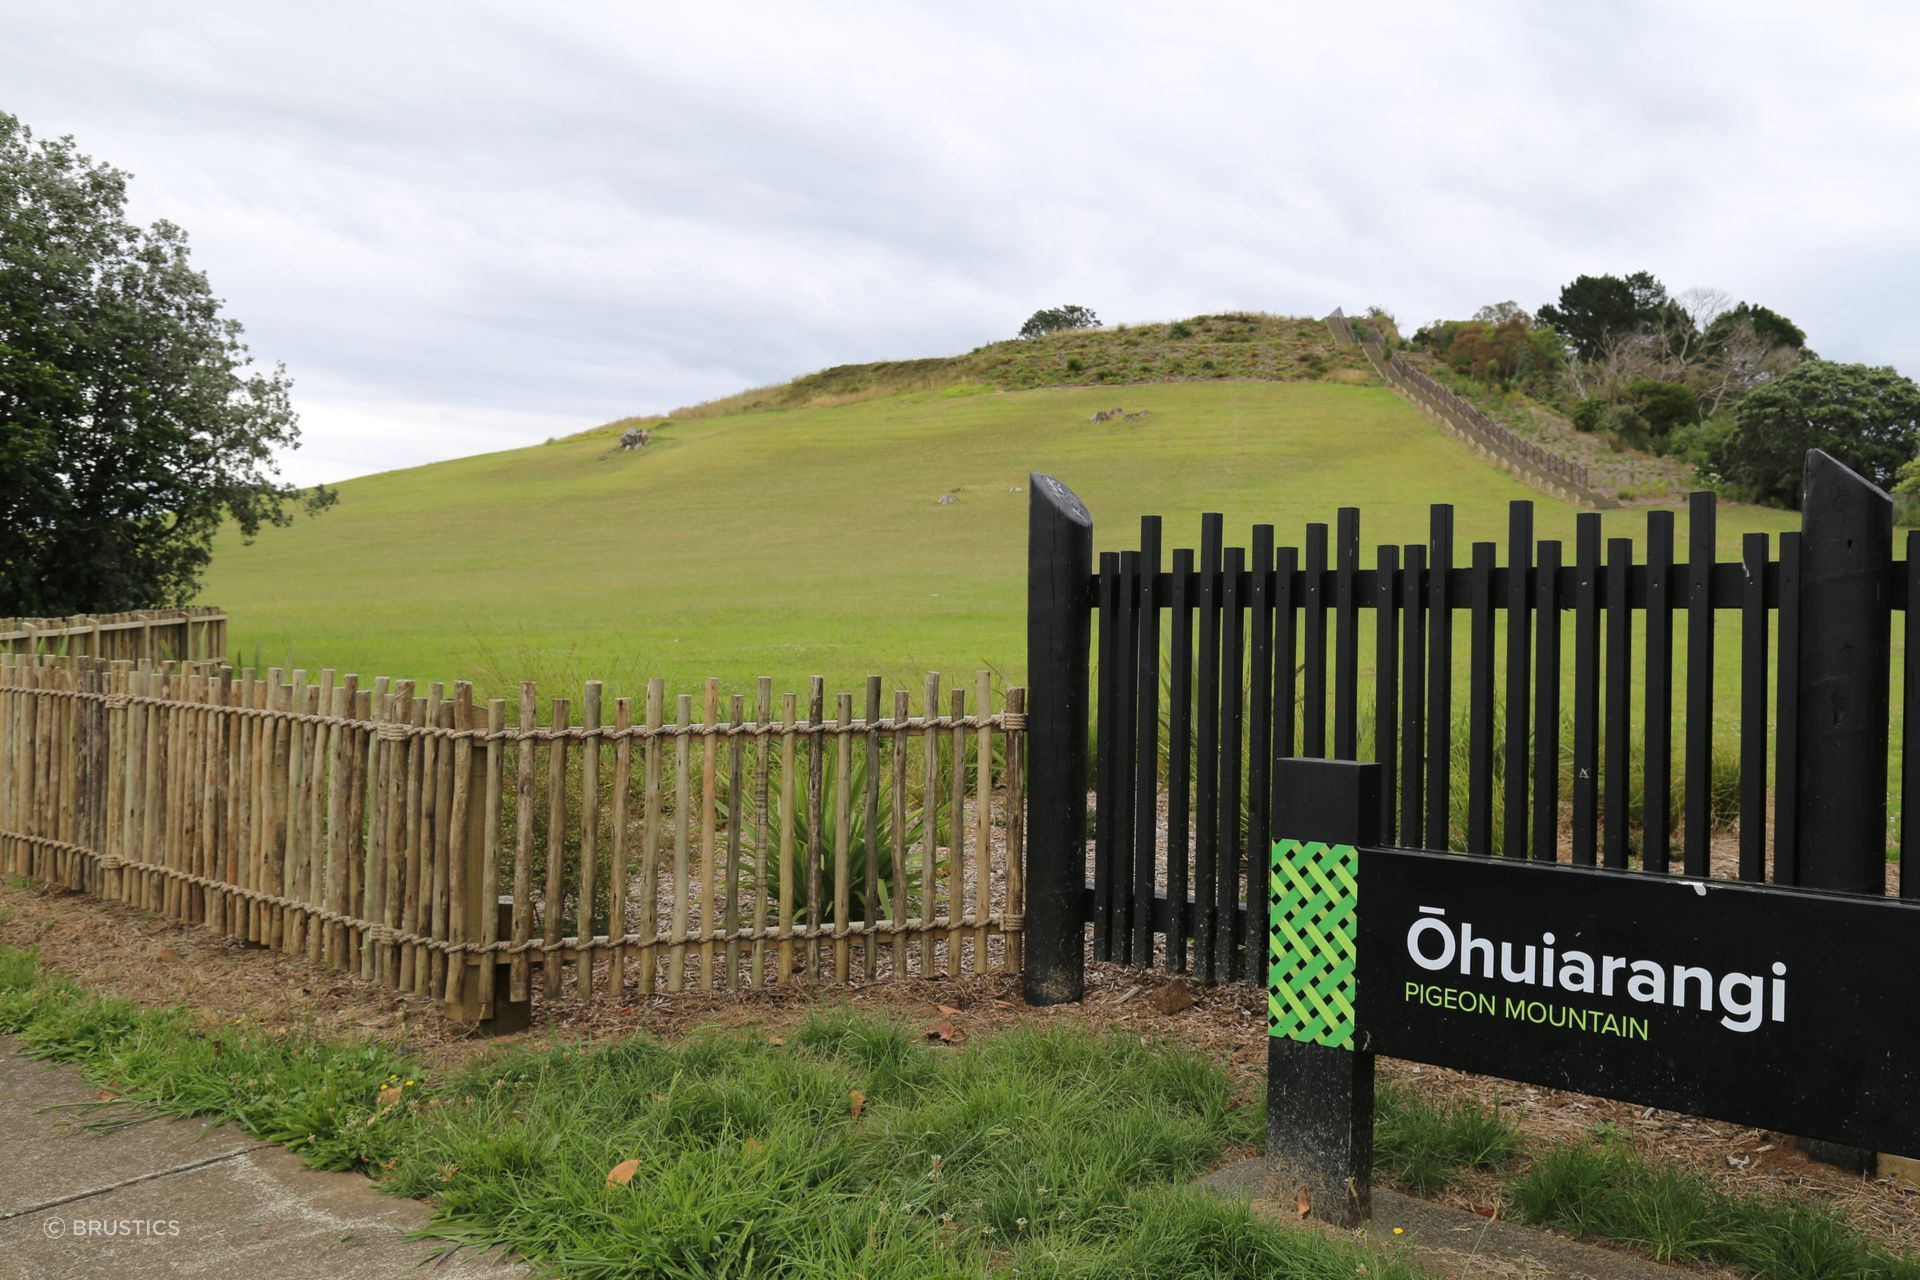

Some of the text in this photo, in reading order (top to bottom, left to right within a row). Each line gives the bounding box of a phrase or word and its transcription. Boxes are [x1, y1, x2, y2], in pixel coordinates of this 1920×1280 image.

[1405, 981, 1649, 1041] PIGEON MOUNTAIN
[1406, 905, 1787, 1033] Ōhuiarangi
